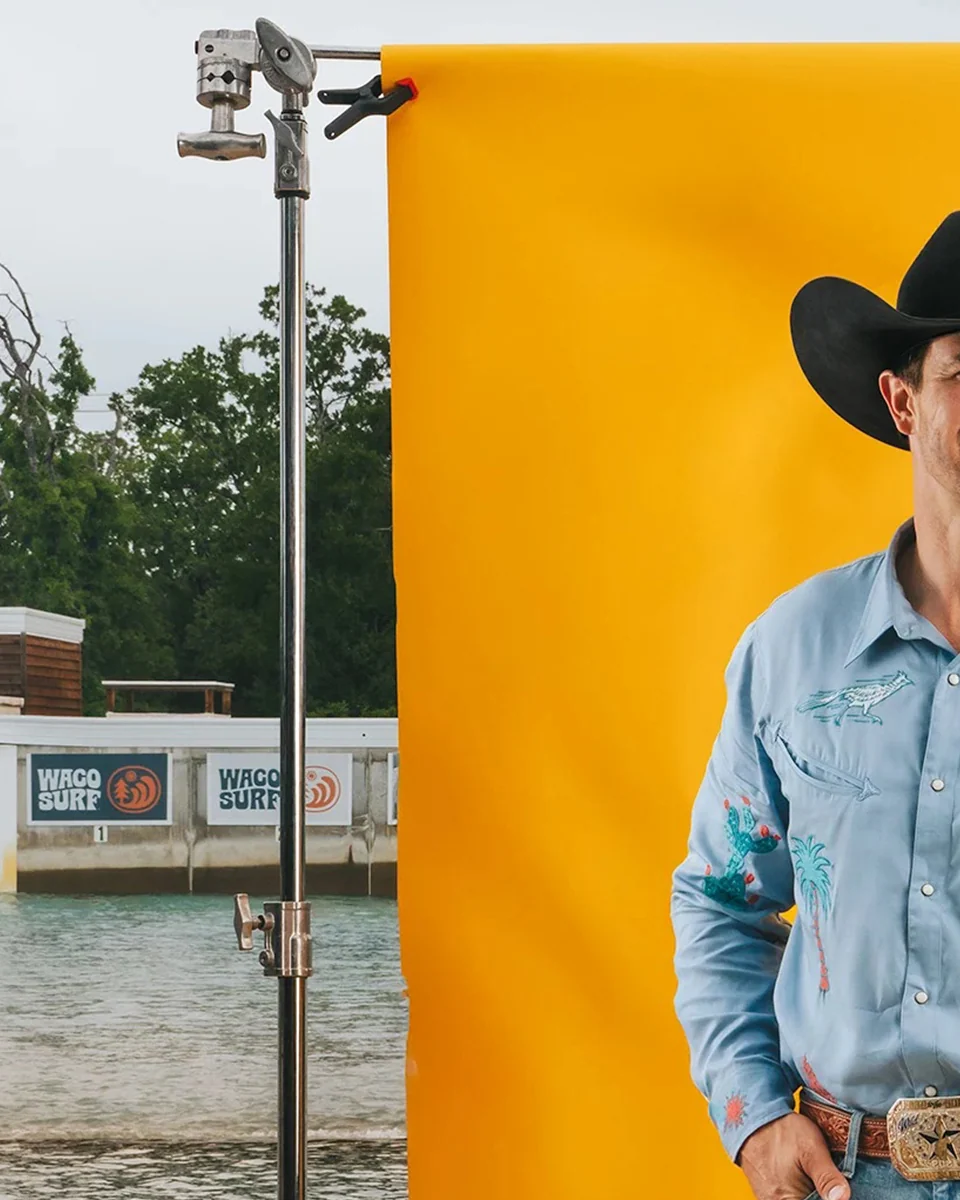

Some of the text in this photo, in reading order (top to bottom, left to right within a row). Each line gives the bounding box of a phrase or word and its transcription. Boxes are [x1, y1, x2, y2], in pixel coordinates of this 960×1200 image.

[37, 768, 101, 791] WACO
[219, 768, 280, 790] WACO
[38, 788, 101, 811] SURF
[219, 788, 280, 810] SURF
[98, 826, 104, 841] 1
